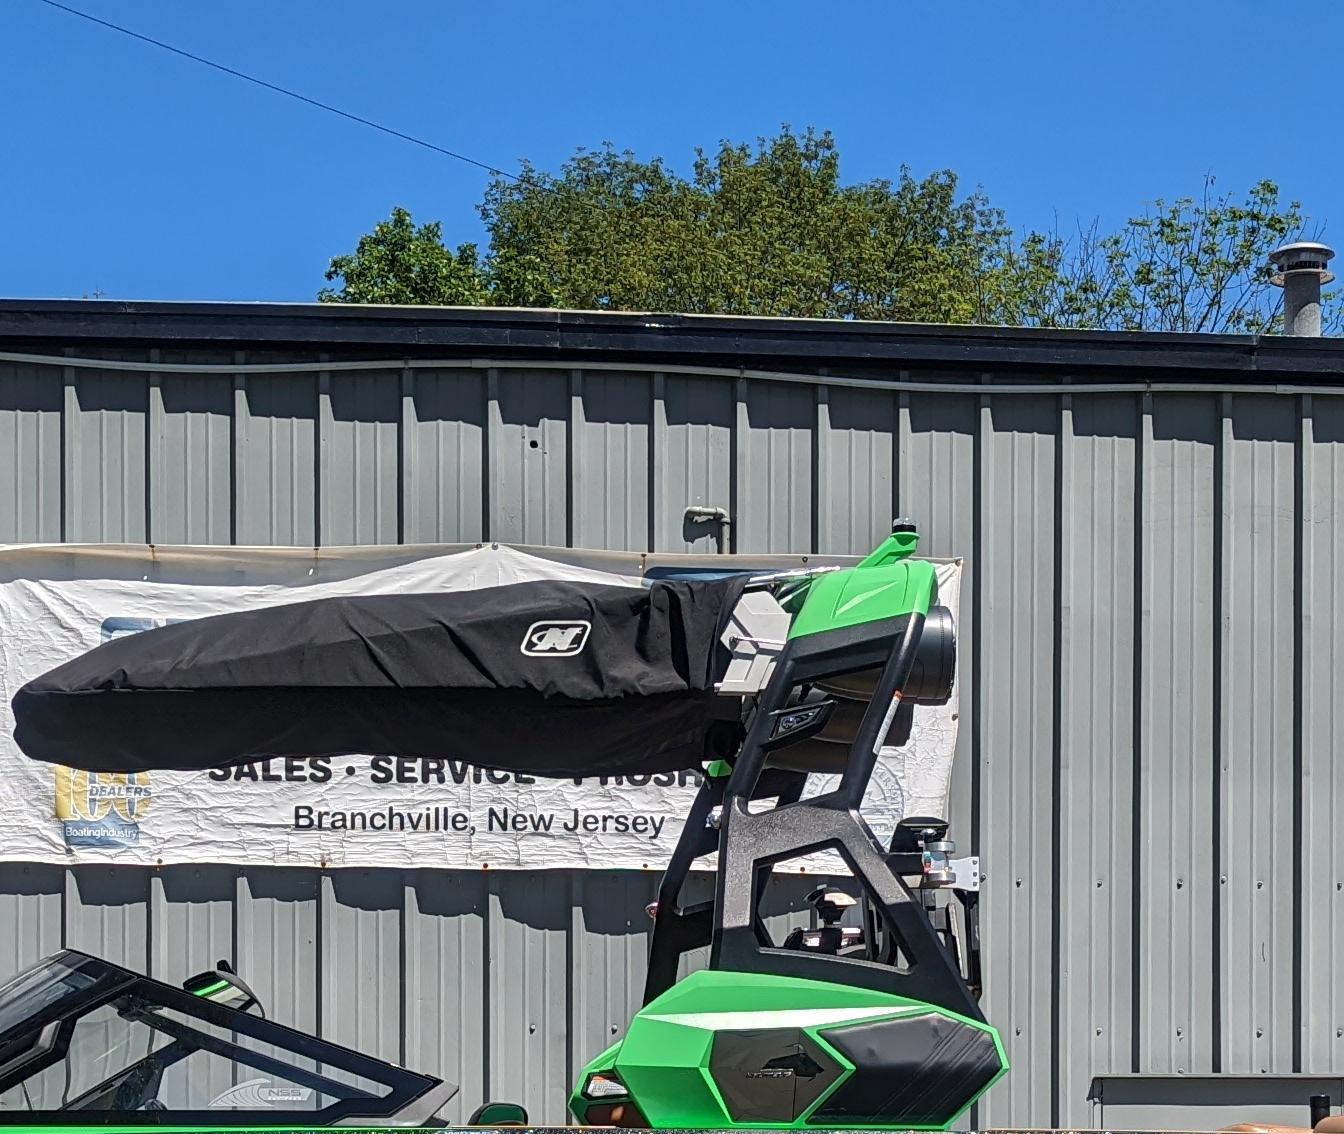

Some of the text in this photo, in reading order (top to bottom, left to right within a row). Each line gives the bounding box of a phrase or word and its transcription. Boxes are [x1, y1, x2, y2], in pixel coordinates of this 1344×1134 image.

[88, 784, 153, 797] DEALERS
[293, 805, 666, 839] Branchville, New Jersey
